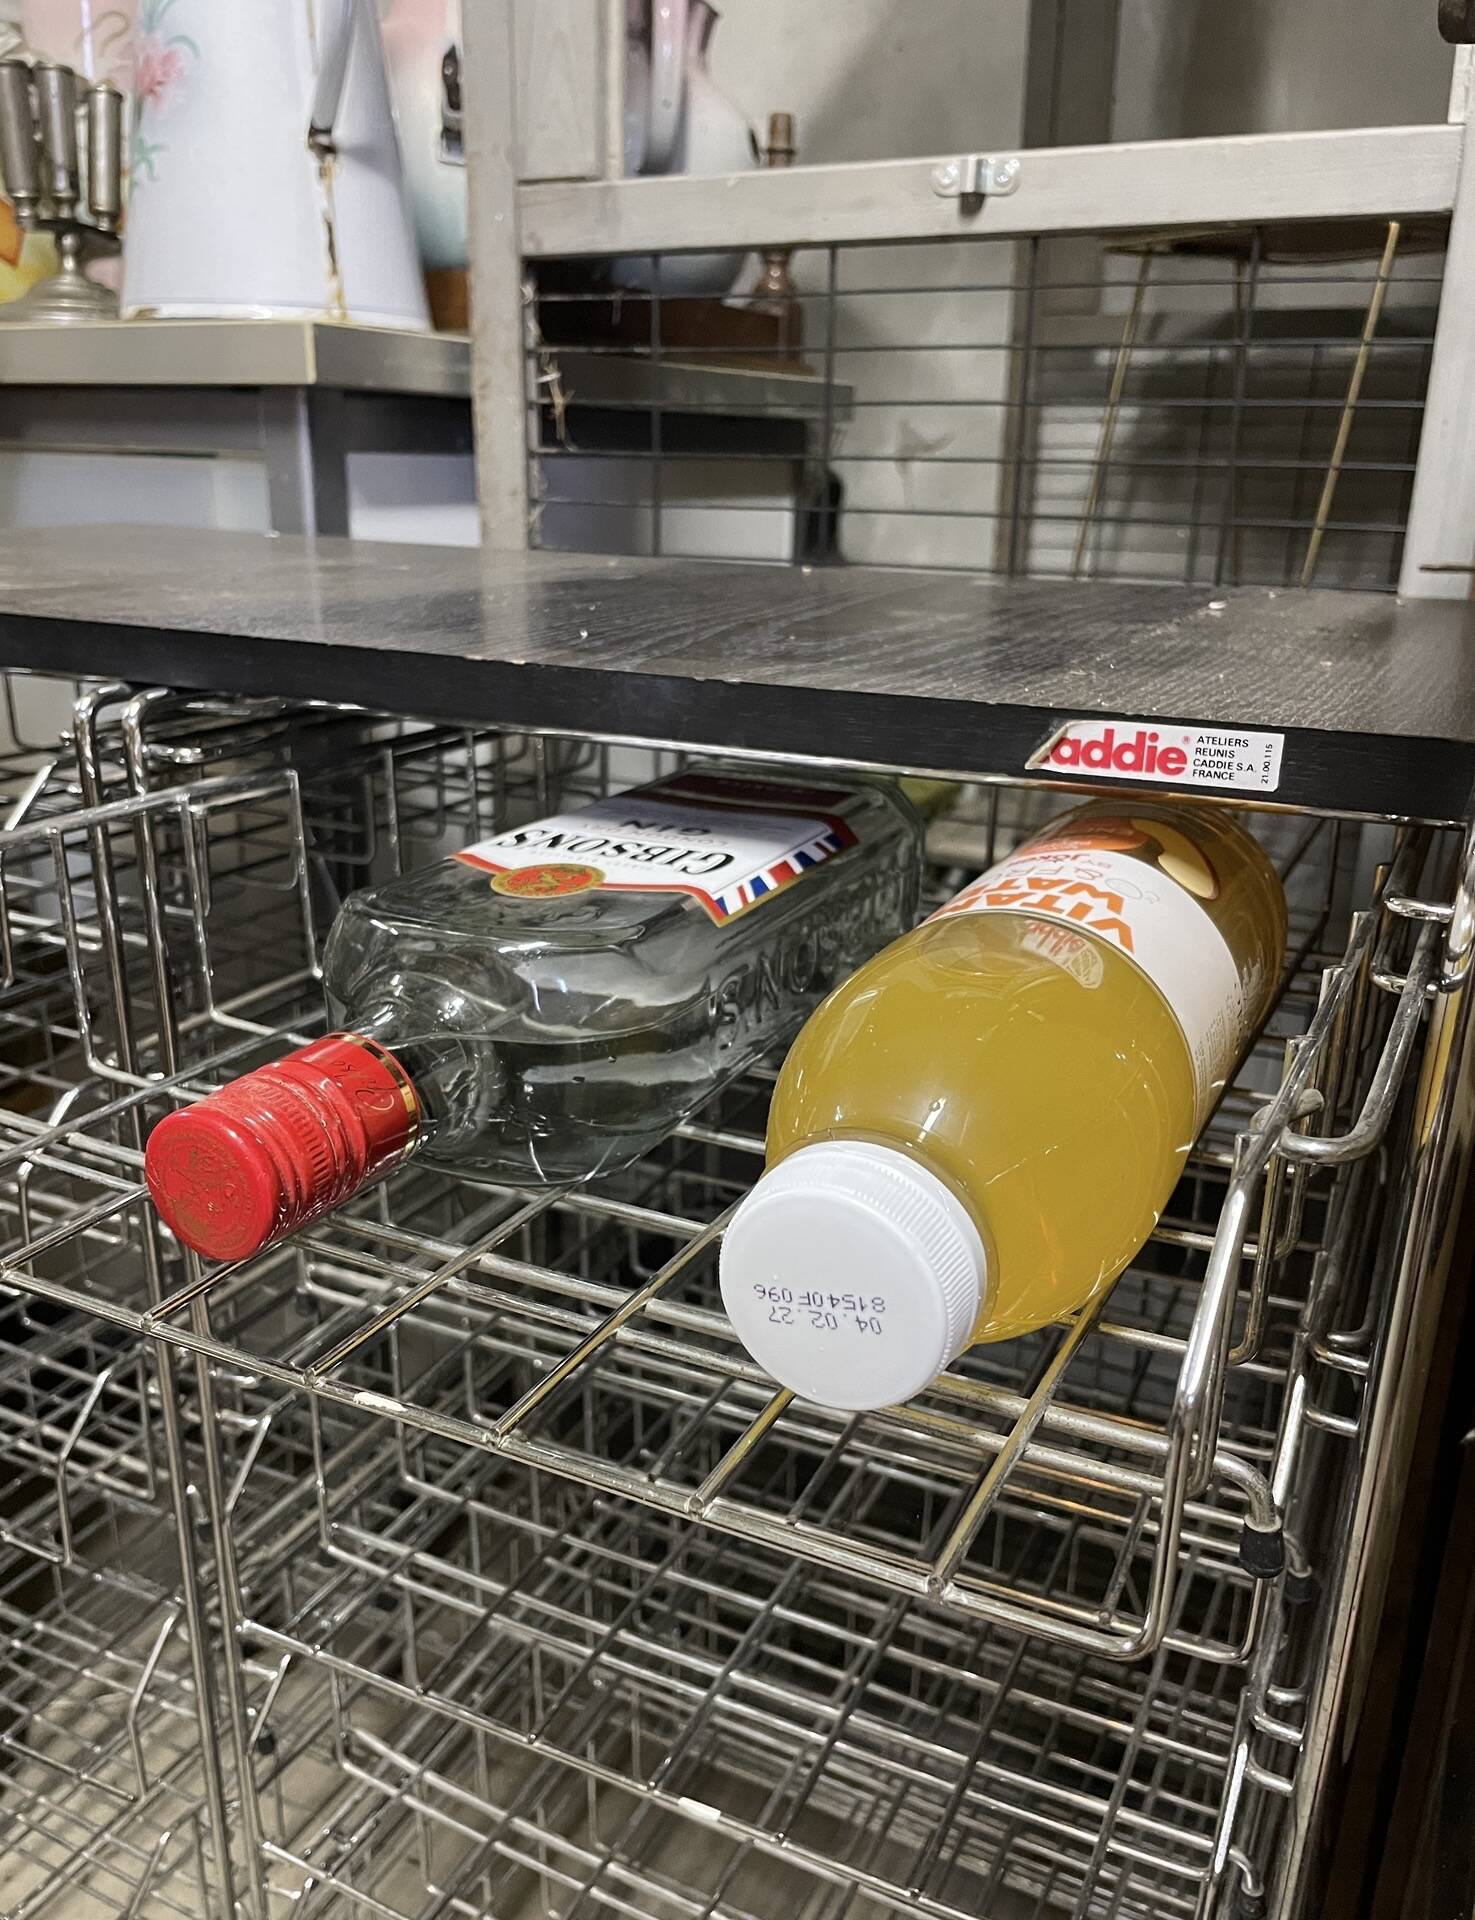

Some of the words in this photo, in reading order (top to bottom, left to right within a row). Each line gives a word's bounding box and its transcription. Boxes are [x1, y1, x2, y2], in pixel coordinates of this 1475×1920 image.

[1197, 736, 1249, 748] ATELIERS
[1040, 728, 1188, 776] addie
[1195, 747, 1235, 759] REUNIS
[1193, 759, 1233, 771] CADDIE
[1236, 762, 1257, 773] S.A.
[1192, 769, 1235, 781] FRANCE
[619, 820, 712, 836] GIN
